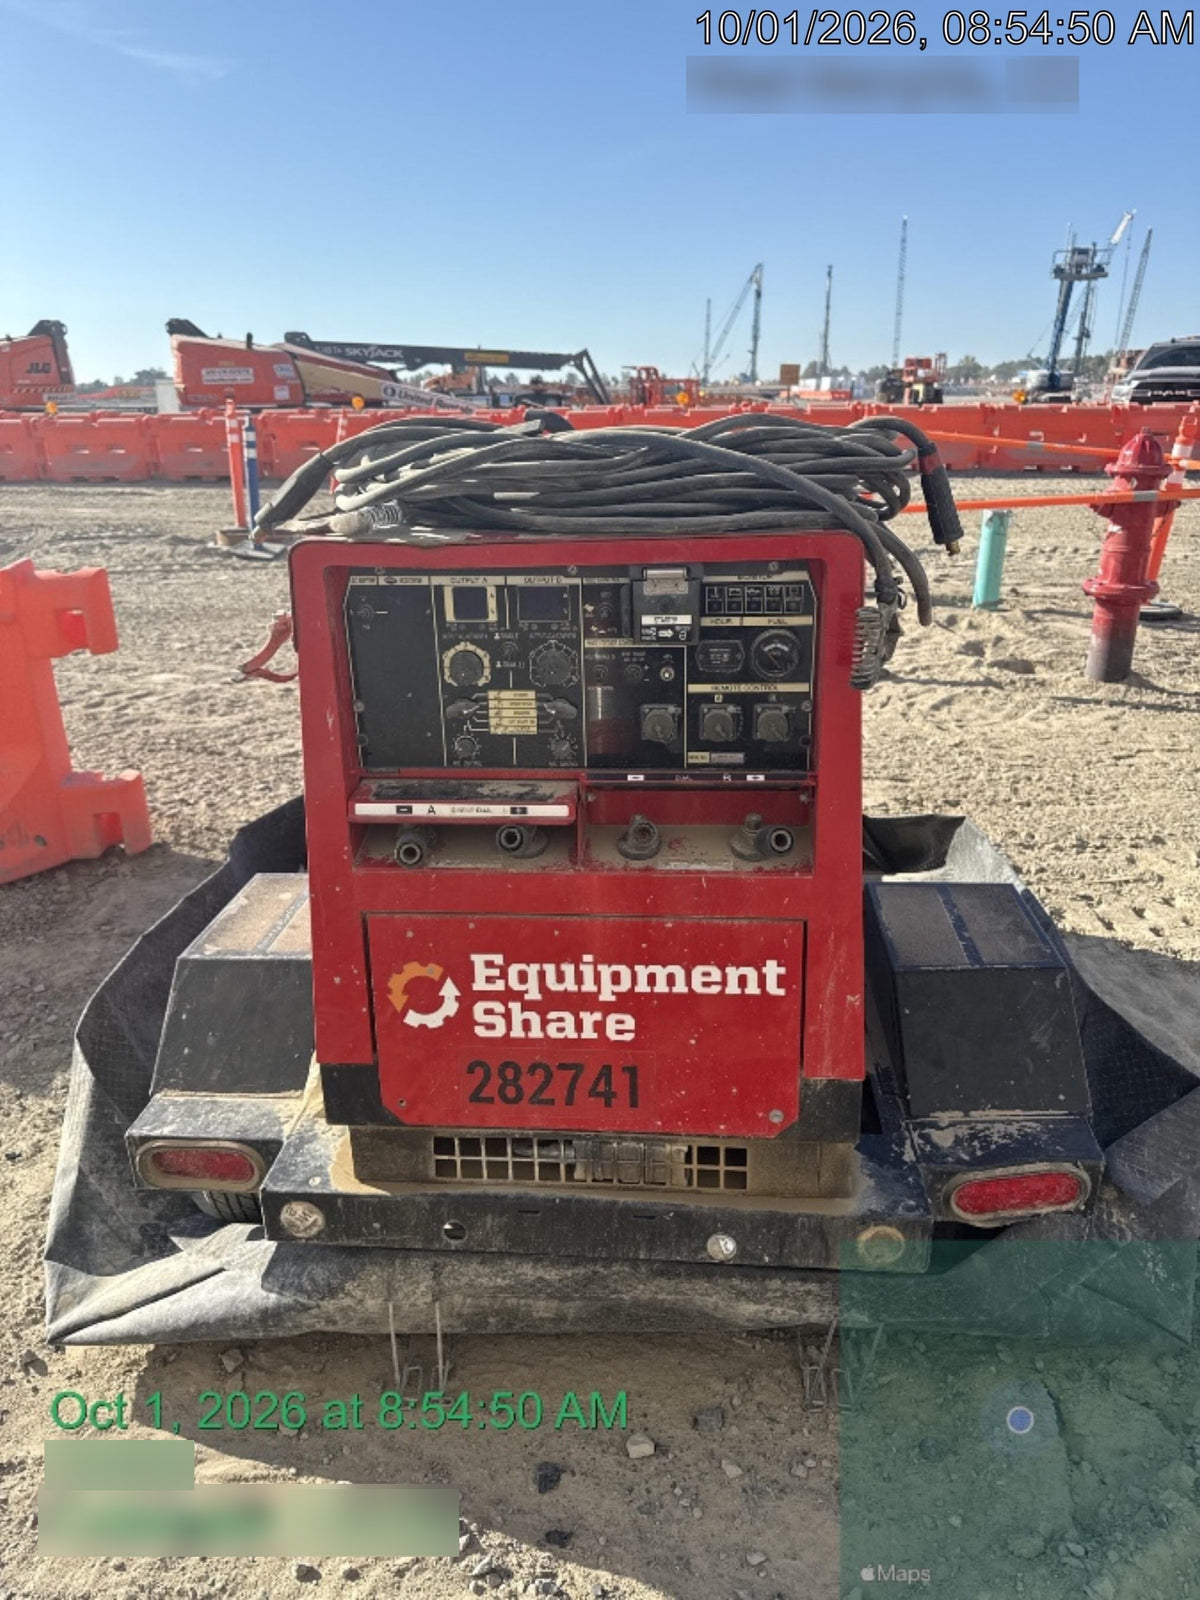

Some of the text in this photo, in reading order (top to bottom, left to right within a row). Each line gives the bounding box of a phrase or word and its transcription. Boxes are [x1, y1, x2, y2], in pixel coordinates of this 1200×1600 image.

[26, 362, 51, 374] JLG
[345, 346, 404, 358] SKYJACK
[470, 952, 787, 1001] Equipment
[472, 1000, 636, 1041] Share
[466, 1059, 640, 1108] 282741
